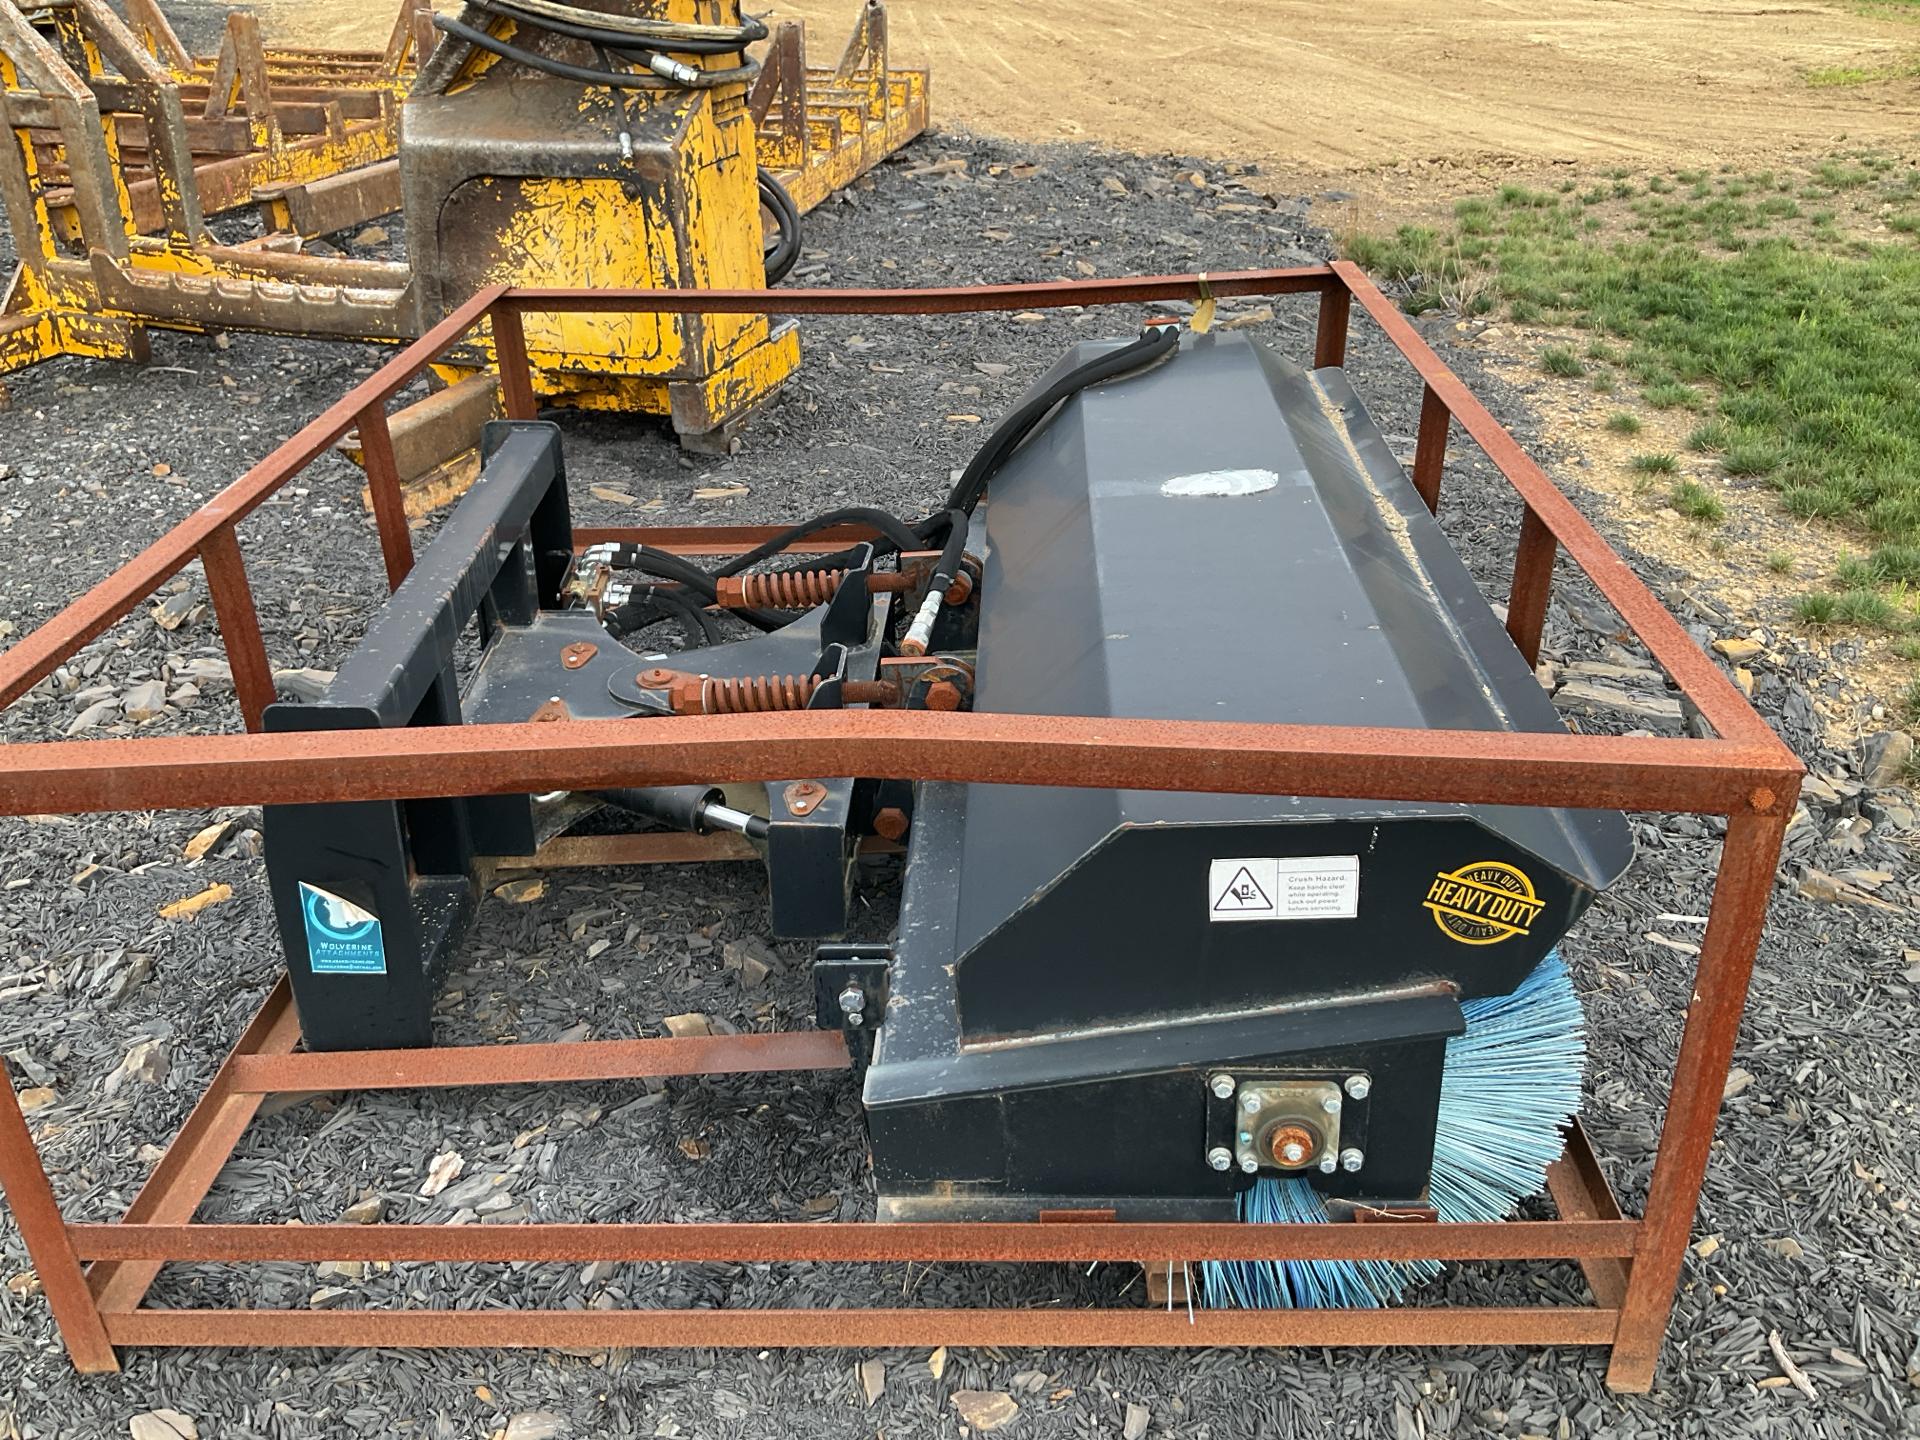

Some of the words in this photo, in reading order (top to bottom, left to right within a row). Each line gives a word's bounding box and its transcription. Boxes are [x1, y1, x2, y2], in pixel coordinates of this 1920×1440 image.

[1466, 871, 1502, 882] HEAVY
[1500, 874, 1524, 894] DUTY
[1426, 879, 1492, 913] HEAVY
[1487, 895, 1542, 927] DUTY
[316, 948, 380, 957] ATTACHMENTS
[320, 942, 373, 951] WOLVERINE
